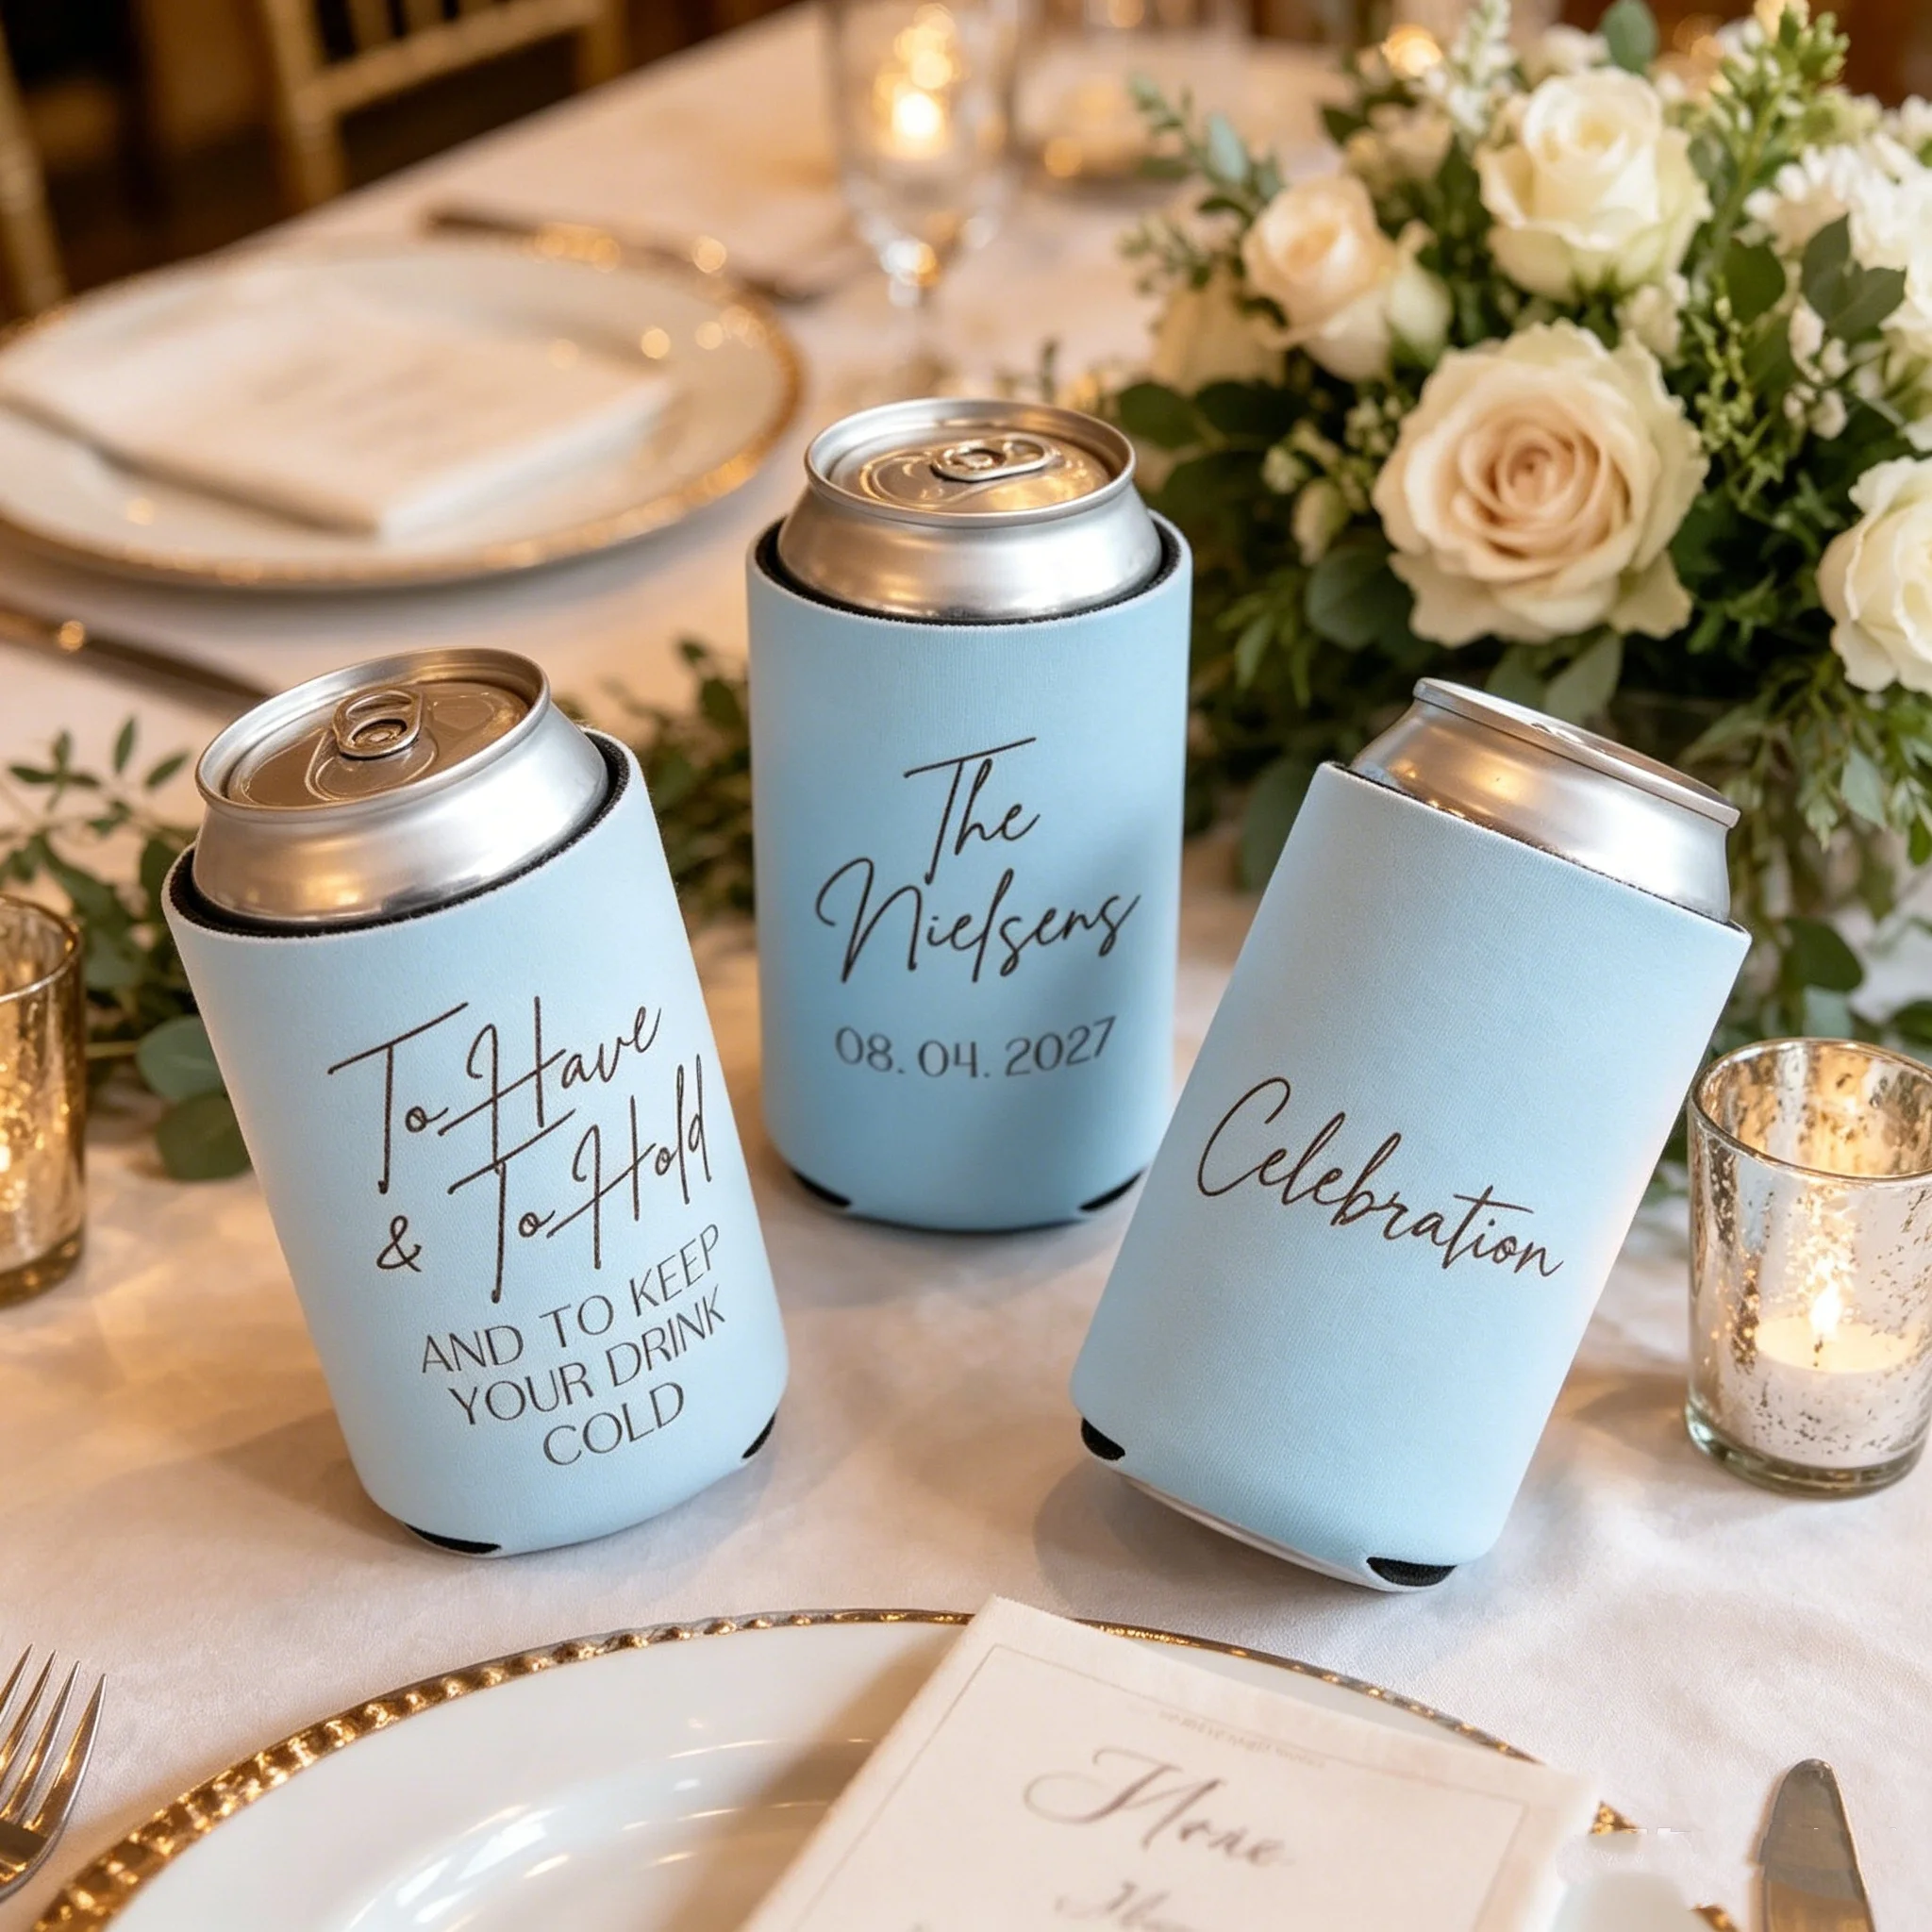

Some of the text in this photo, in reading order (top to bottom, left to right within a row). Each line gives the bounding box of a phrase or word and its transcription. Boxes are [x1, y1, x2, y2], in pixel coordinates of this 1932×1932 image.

[902, 736, 1041, 886] The
[815, 856, 1142, 984] Nielsens
[326, 995, 662, 1196] To Have
[375, 1053, 713, 1305] & To Hold
[1196, 1075, 1566, 1278] Celebration
[421, 1223, 720, 1374] AND TO KEEP
[447, 1283, 726, 1426] YOUR DRINK
[542, 1381, 686, 1466] COLD
